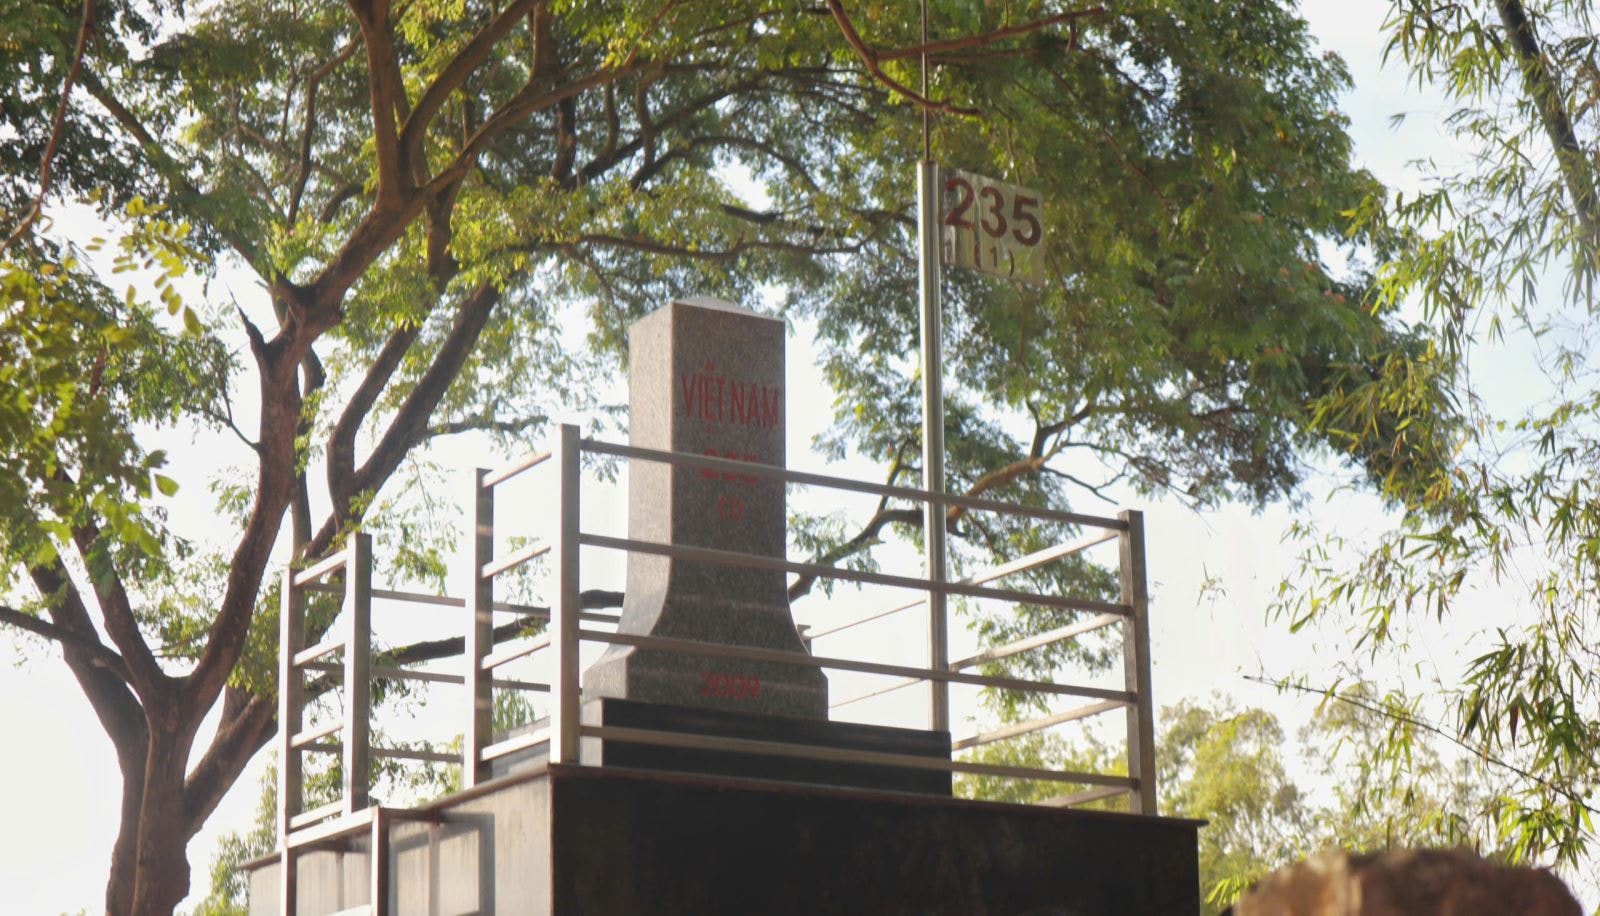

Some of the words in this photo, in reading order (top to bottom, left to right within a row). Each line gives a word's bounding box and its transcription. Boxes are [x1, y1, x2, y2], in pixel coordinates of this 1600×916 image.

[944, 176, 1042, 247] 235
[974, 242, 1015, 278] (1)
[681, 359, 726, 434] VIỆT
[730, 379, 779, 432] NAM
